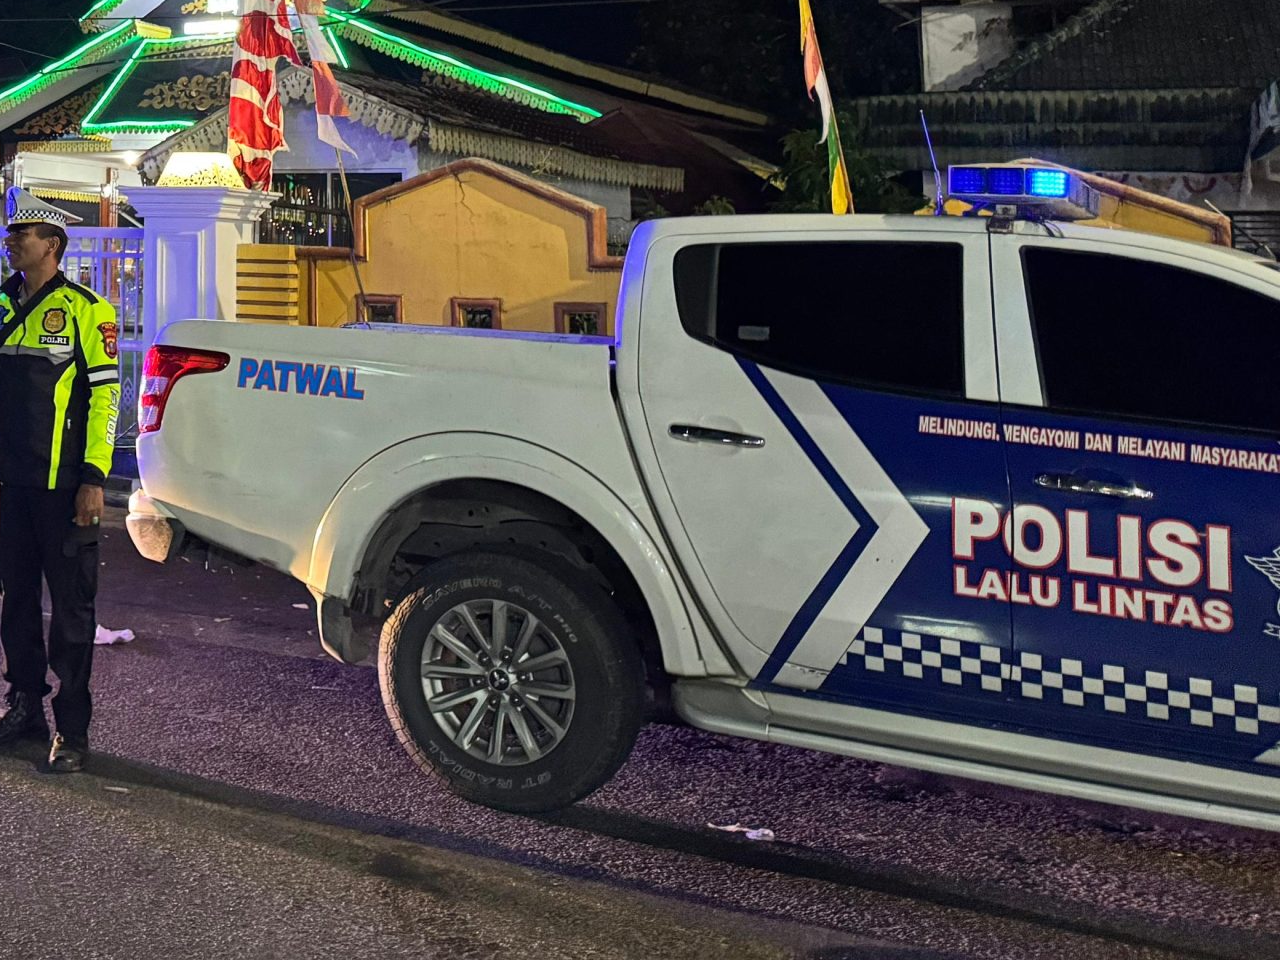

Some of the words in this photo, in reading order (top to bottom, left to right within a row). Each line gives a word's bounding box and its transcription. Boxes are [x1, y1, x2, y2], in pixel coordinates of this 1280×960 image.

[39, 335, 68, 346] POLRI
[237, 357, 365, 400] PATWAL
[1003, 424, 1080, 450] MENGAYOMI
[1084, 432, 1113, 453] DAN
[1117, 435, 1186, 462] MELAYANI
[951, 496, 1232, 592] POLISI
[953, 564, 1061, 607] LALU
[1072, 580, 1234, 633] LINTAS
